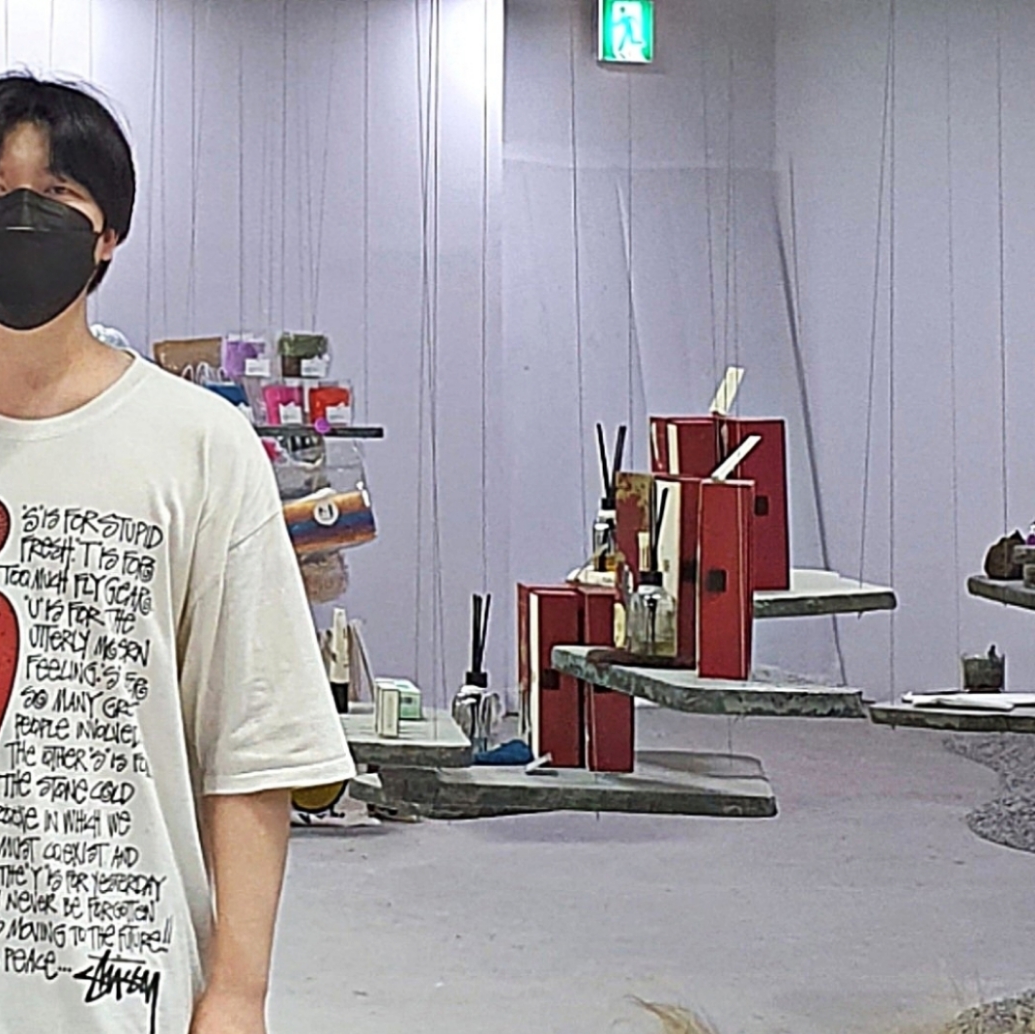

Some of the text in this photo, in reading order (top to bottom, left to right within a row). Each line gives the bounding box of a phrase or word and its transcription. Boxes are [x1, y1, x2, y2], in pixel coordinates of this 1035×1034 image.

[64, 508, 99, 534] FOR
[97, 513, 163, 549] STUPID
[31, 567, 68, 594] MUCH
[74, 573, 107, 602] FLY
[68, 602, 105, 627] FOR
[29, 624, 90, 659] UTTERLY
[52, 688, 104, 718] MANY
[15, 713, 70, 740] PEOPLE
[5, 740, 36, 769] THE
[41, 745, 88, 772] OTHER
